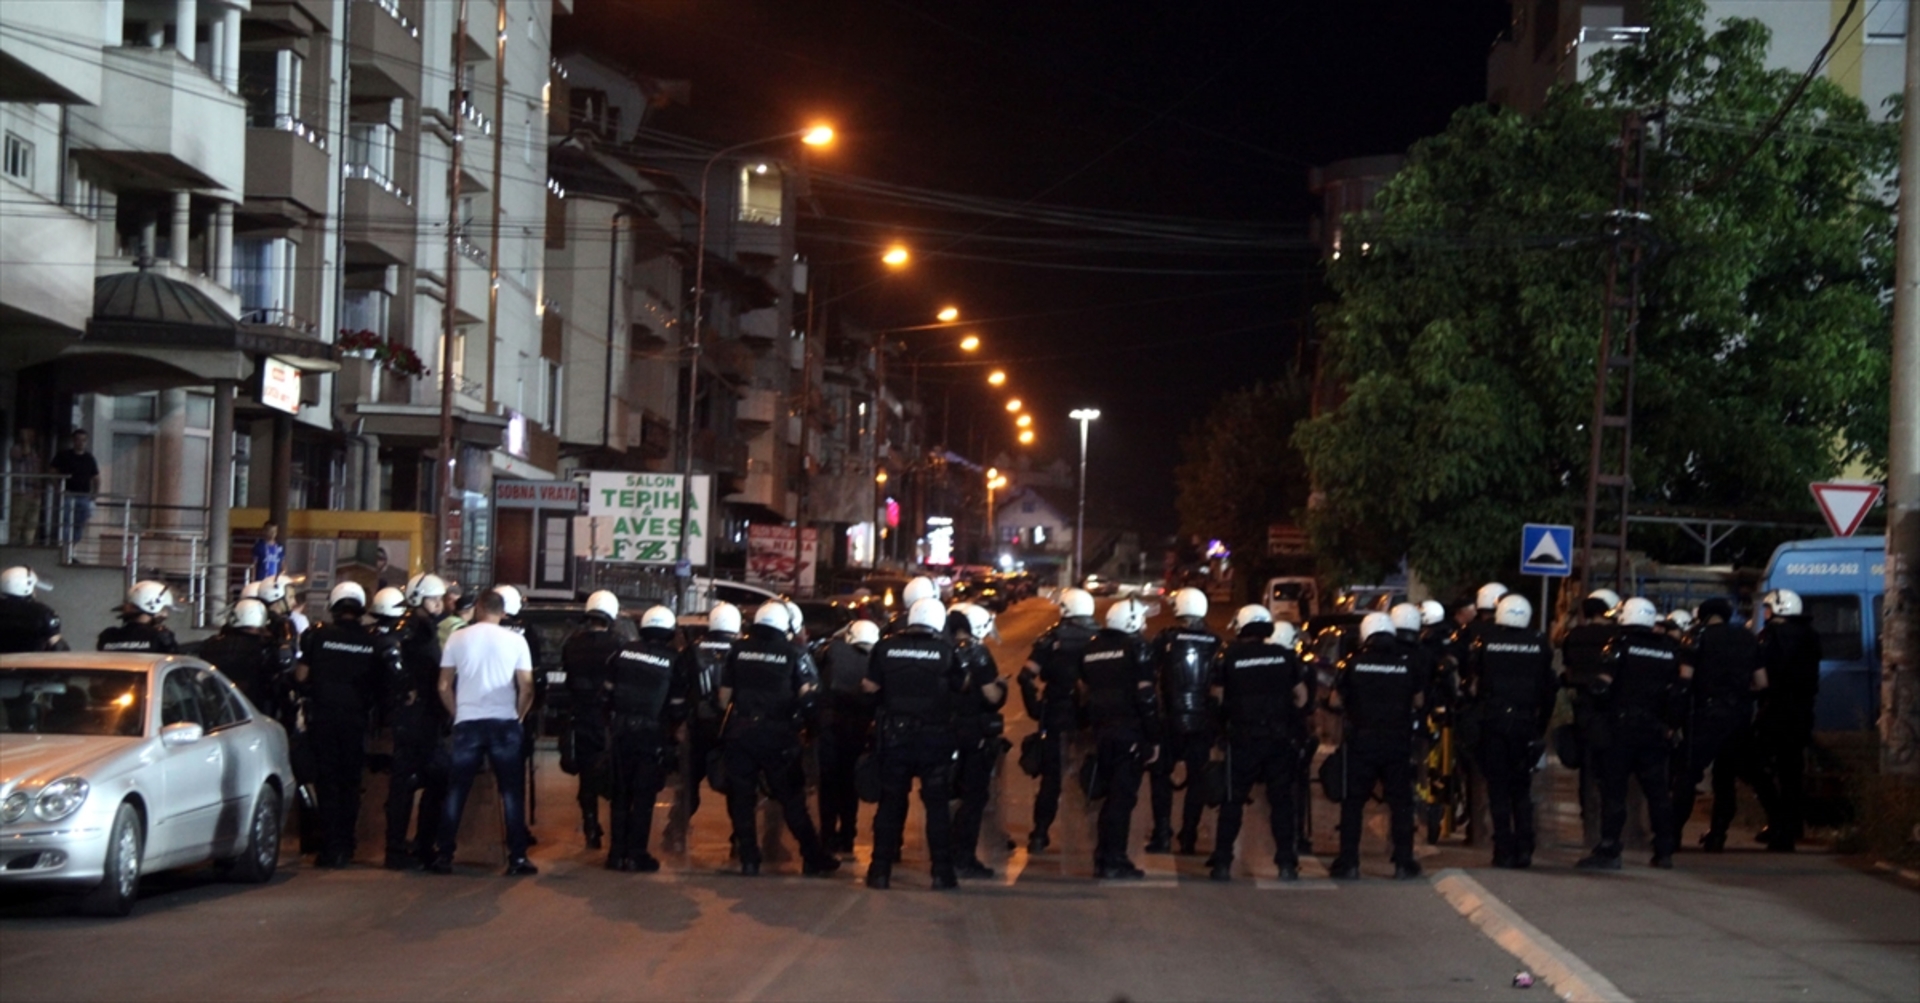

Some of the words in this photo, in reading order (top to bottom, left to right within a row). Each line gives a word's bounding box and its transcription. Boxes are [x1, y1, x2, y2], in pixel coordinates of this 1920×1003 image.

[626, 475, 676, 488] SALON
[497, 484, 536, 499] SOBNA
[540, 485, 577, 501] VRATA
[600, 488, 699, 510] TEPIHA
[642, 504, 653, 516] &
[613, 517, 703, 537] AVESA
[323, 641, 374, 654] ПОЛИЦИЈА
[887, 648, 941, 660] ПОЛИЦИЈА
[1487, 642, 1541, 654] ПОЛИЦИЈА
[621, 650, 670, 668] ПОЛИЦИЈА
